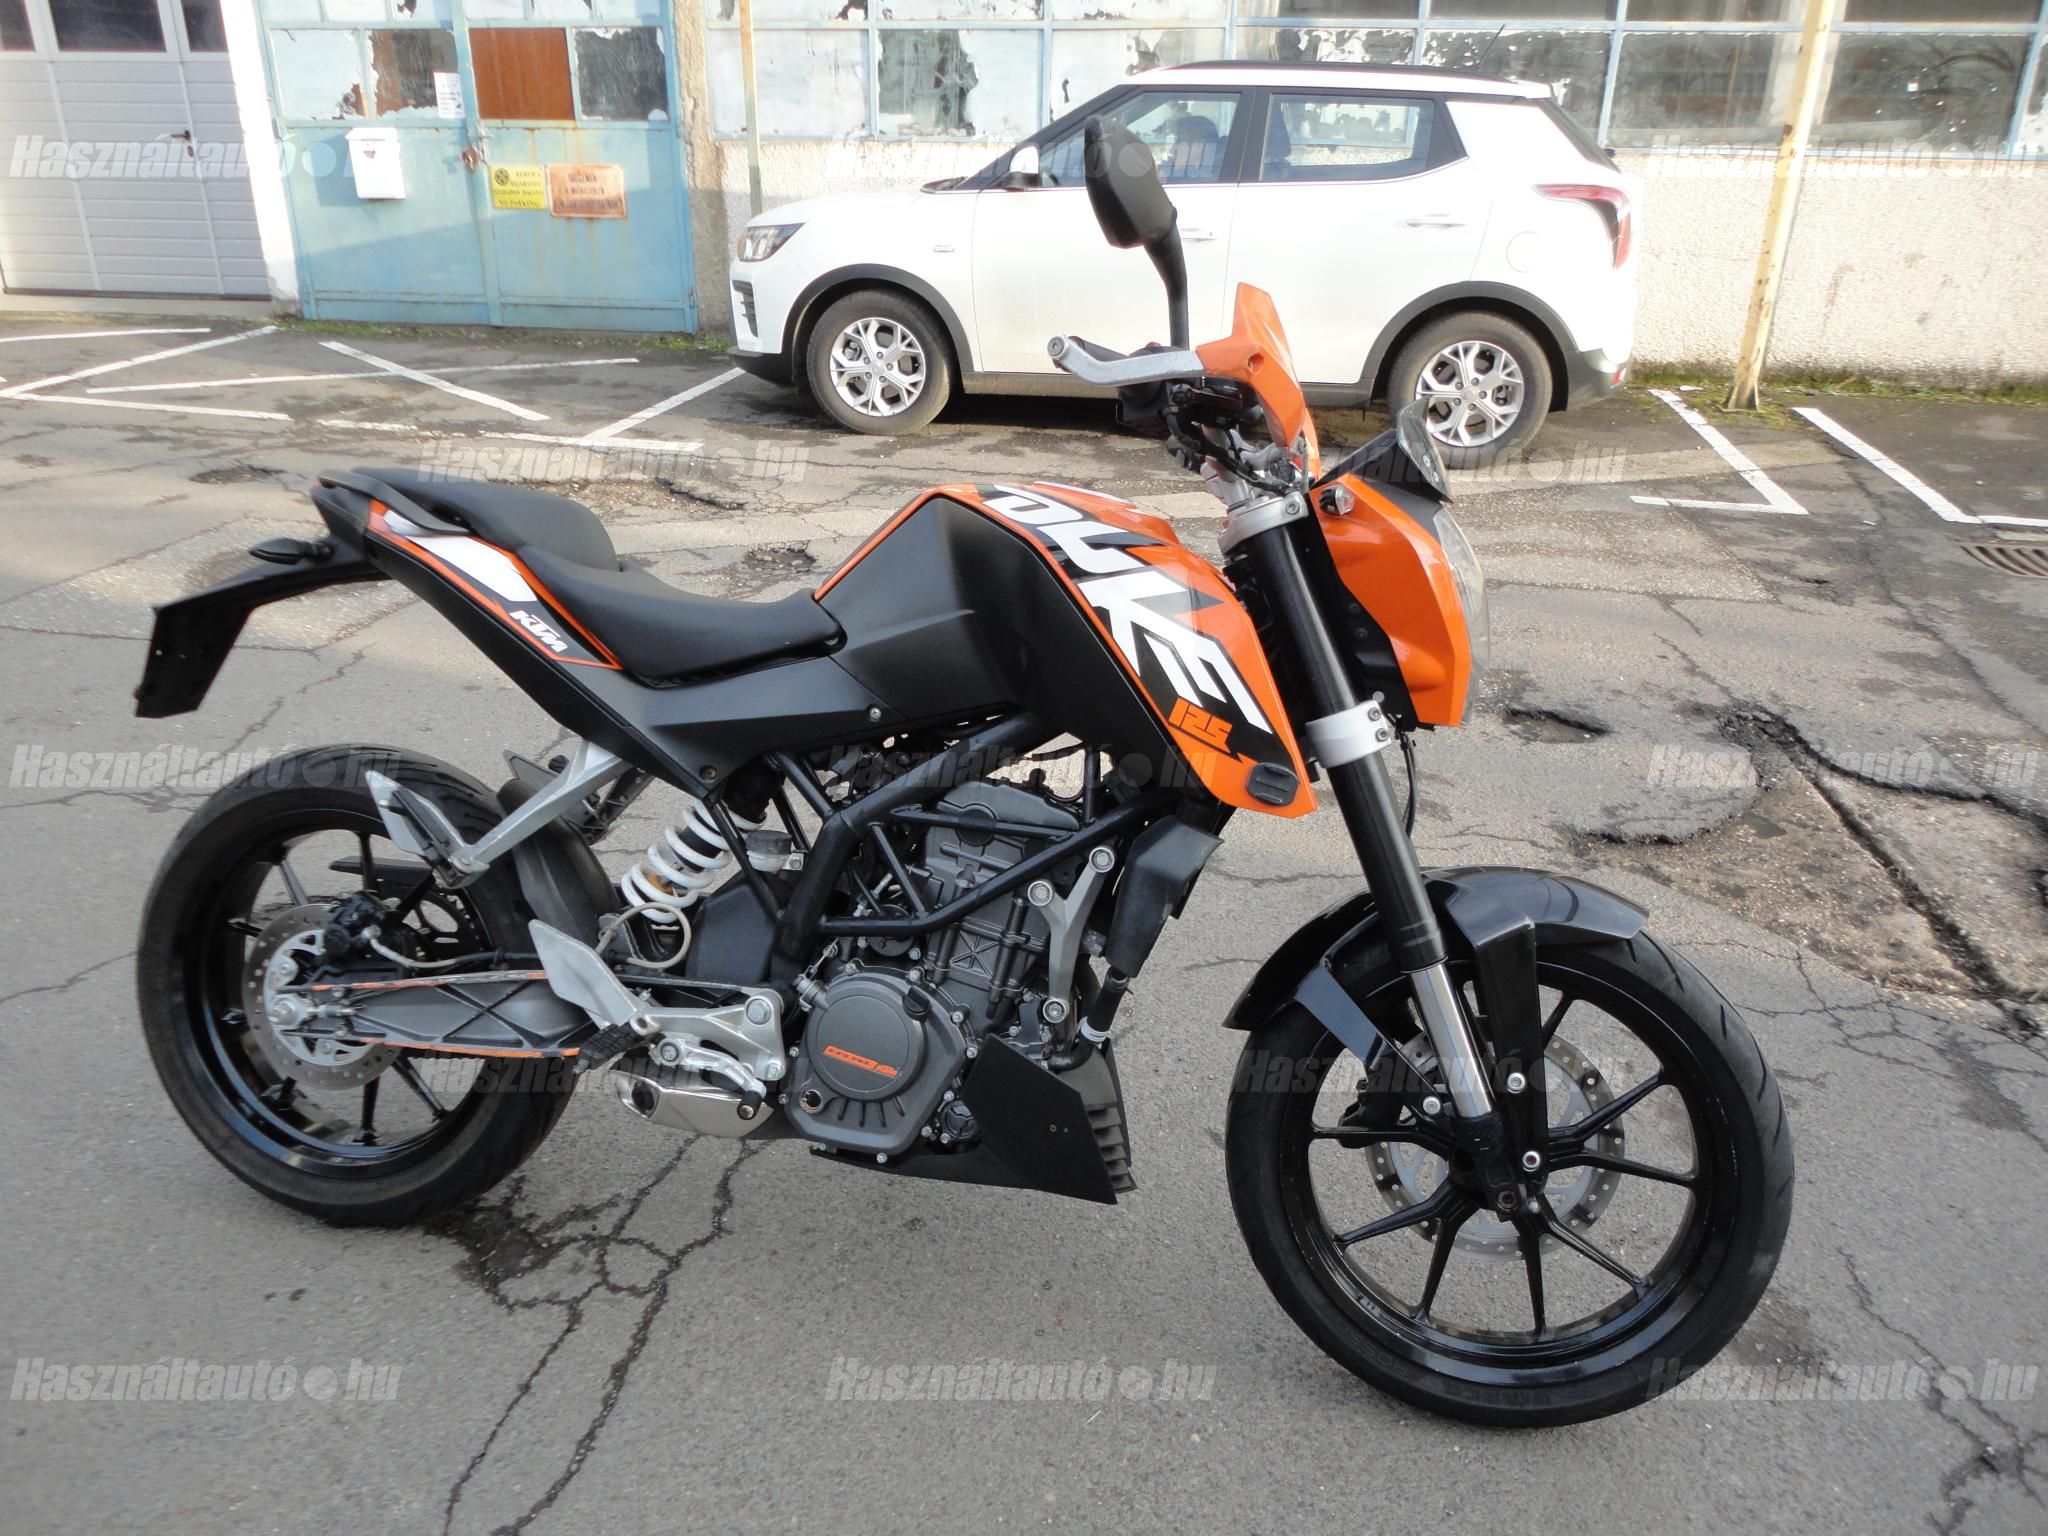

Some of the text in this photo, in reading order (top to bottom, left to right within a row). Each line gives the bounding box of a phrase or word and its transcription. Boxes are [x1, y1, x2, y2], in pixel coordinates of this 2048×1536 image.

[508, 610, 568, 653] KTM
[982, 484, 1273, 735] DUKE
[1168, 696, 1233, 746] 125
